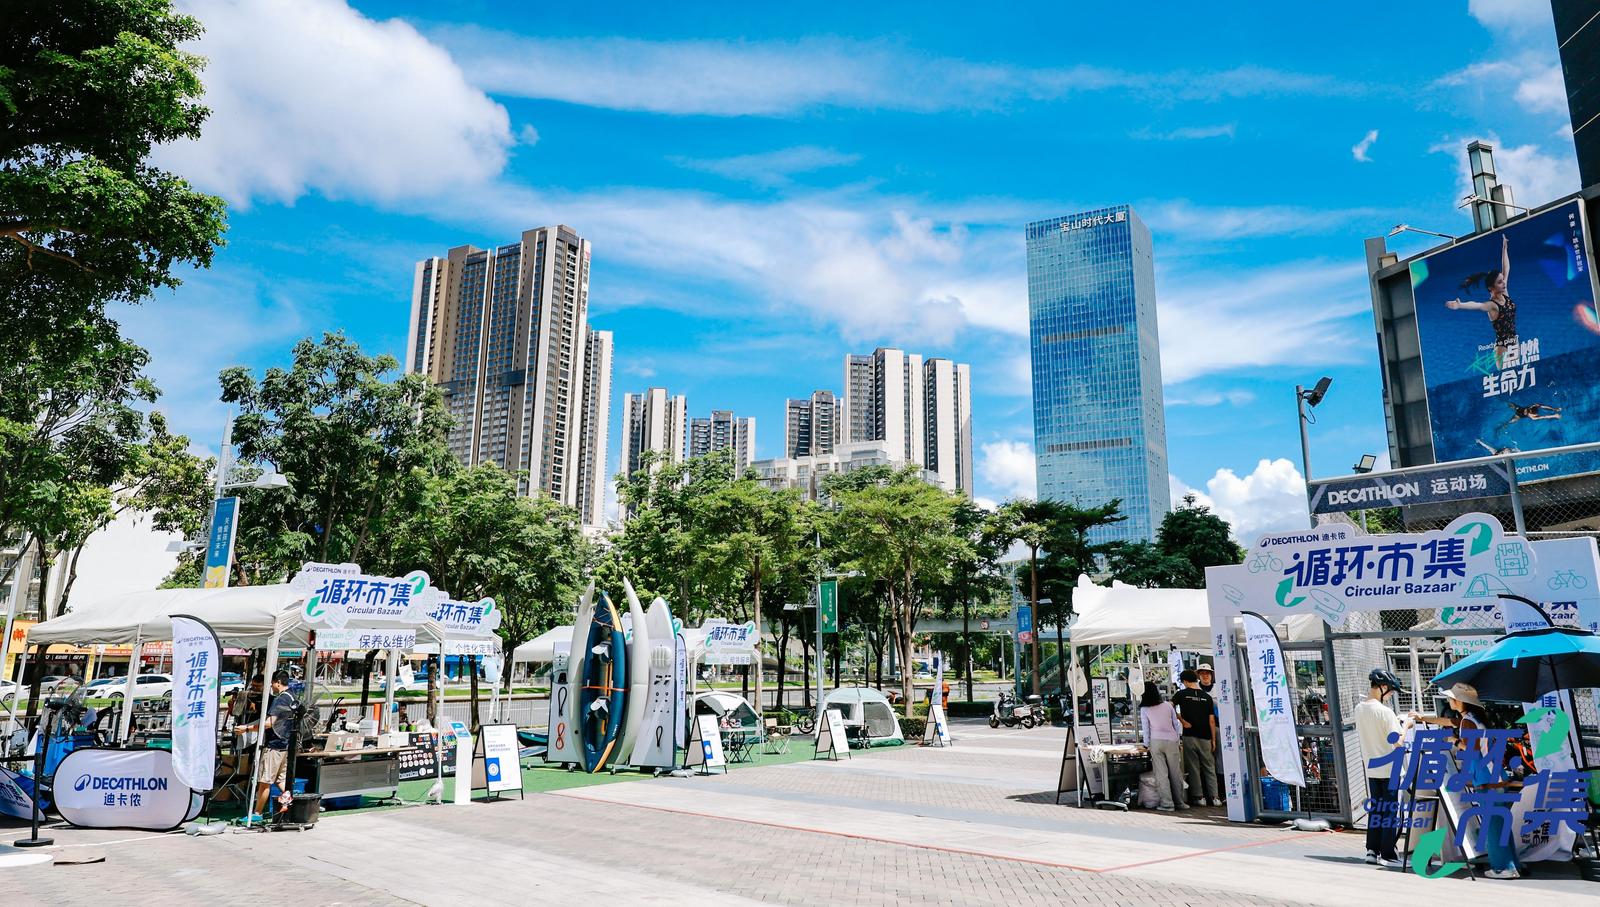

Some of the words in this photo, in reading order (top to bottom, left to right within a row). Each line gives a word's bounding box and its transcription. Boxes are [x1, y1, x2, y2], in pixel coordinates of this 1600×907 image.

[1060, 211, 1127, 232] 宝山时代大厦
[1483, 364, 1536, 398] 生命力
[1328, 481, 1420, 505] DECATHLON
[1430, 474, 1488, 494] 运动场
[1271, 534, 1320, 545] DECATHLON
[1321, 531, 1346, 542] 迪卡侬
[312, 566, 342, 574] DECATHLON
[1284, 537, 1467, 588] 循环市集
[315, 578, 413, 607] 循环市集
[1344, 584, 1402, 598] Circular
[1404, 581, 1457, 595] Bazaar
[346, 606, 377, 614] Circular
[377, 607, 403, 615] Bazaar
[359, 634, 416, 649] 保养&维修
[1451, 639, 1489, 648] Recycle
[186, 651, 209, 720] 循环市集
[1259, 648, 1284, 715] 循环市集
[92, 777, 168, 791] DECATHLON
[103, 792, 142, 807] 迪卡侬
